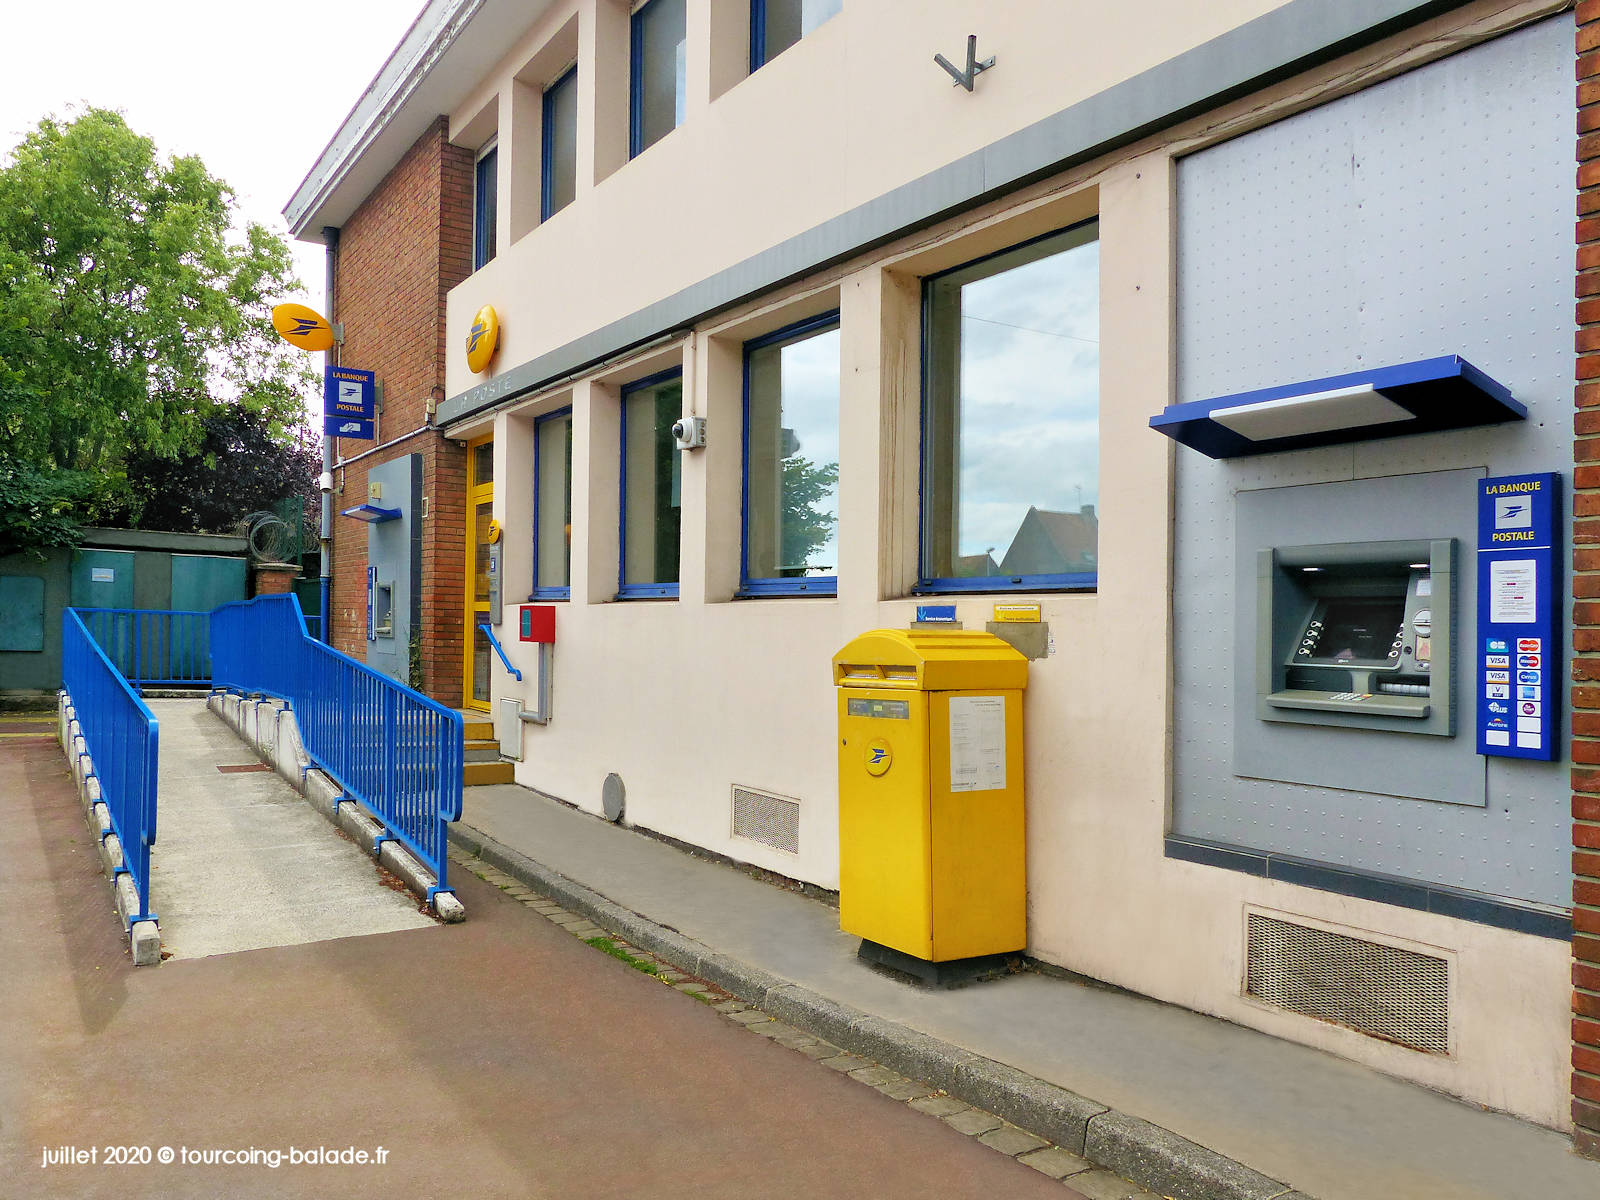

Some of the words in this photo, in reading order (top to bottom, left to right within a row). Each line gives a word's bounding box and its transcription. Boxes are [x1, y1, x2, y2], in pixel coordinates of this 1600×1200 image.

[332, 371, 341, 379] LA
[342, 373, 369, 382] BANQUE
[336, 403, 365, 413] POSTALE
[1486, 485, 1498, 495] LA
[1499, 481, 1541, 493] BANQUE
[1492, 531, 1535, 542] POSTALE
